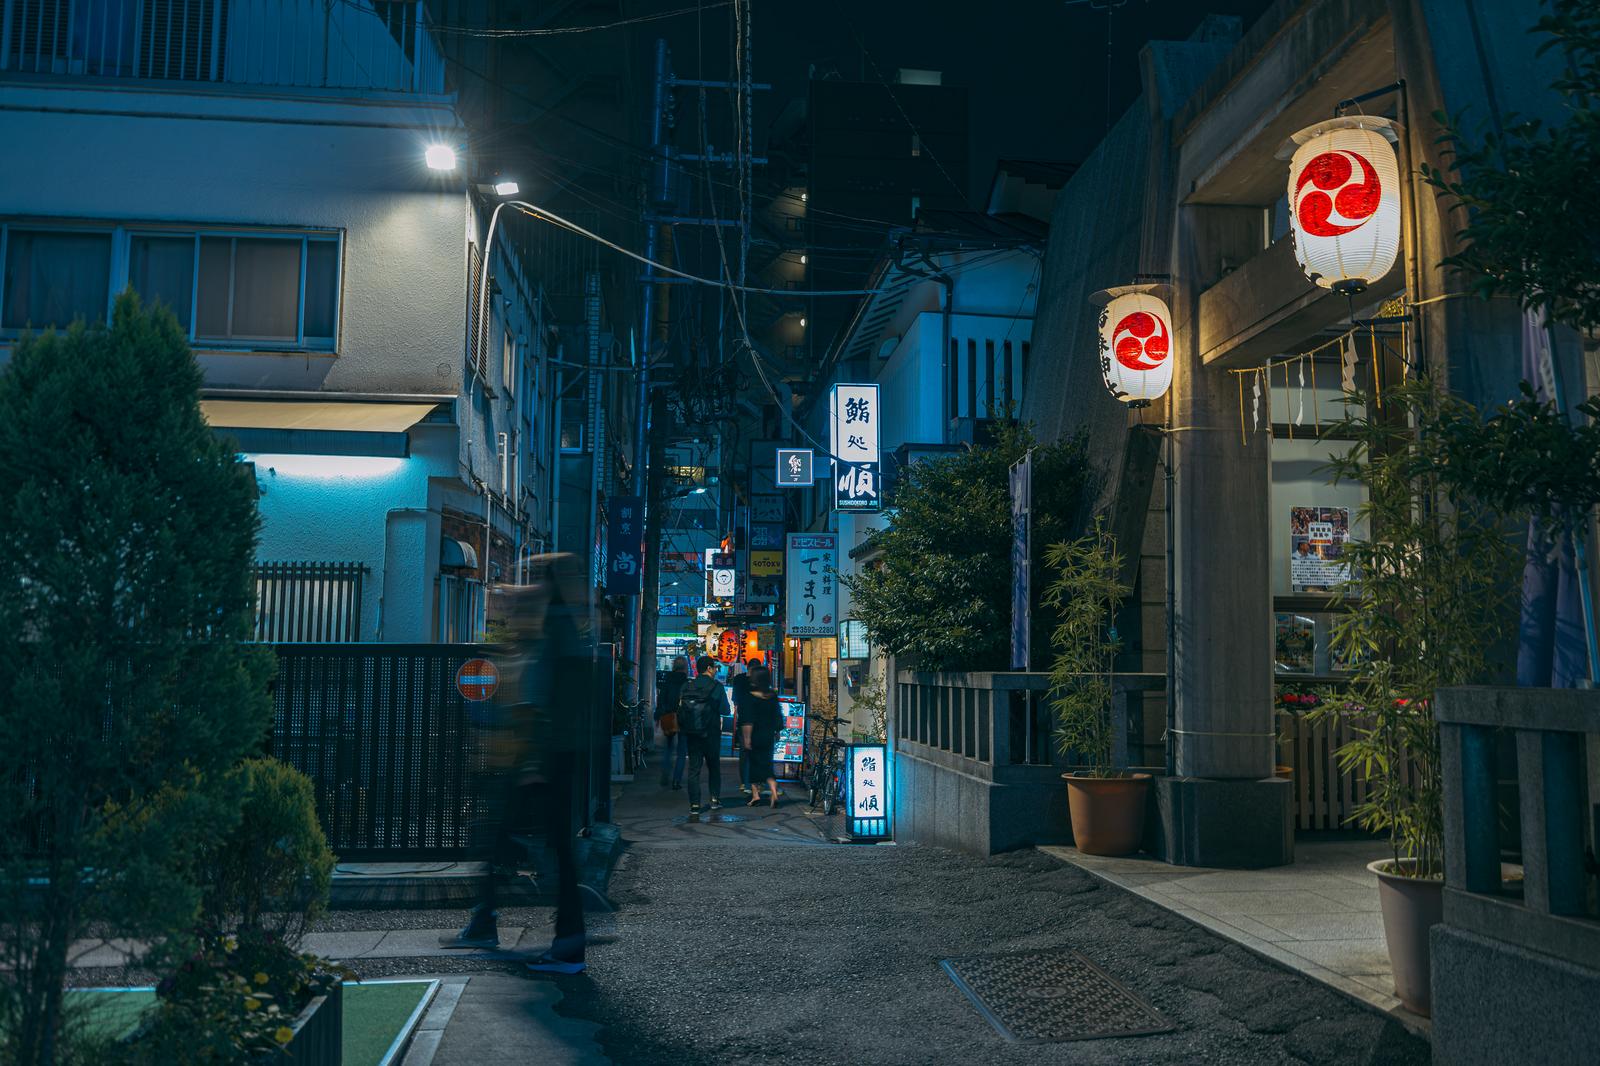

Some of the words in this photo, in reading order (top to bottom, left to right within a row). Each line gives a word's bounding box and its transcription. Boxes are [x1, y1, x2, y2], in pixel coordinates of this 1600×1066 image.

[613, 551, 637, 575] 尚
[822, 552, 832, 595] 家庭料理
[801, 557, 819, 623] てまり
[859, 756, 879, 812] 鮨処順
